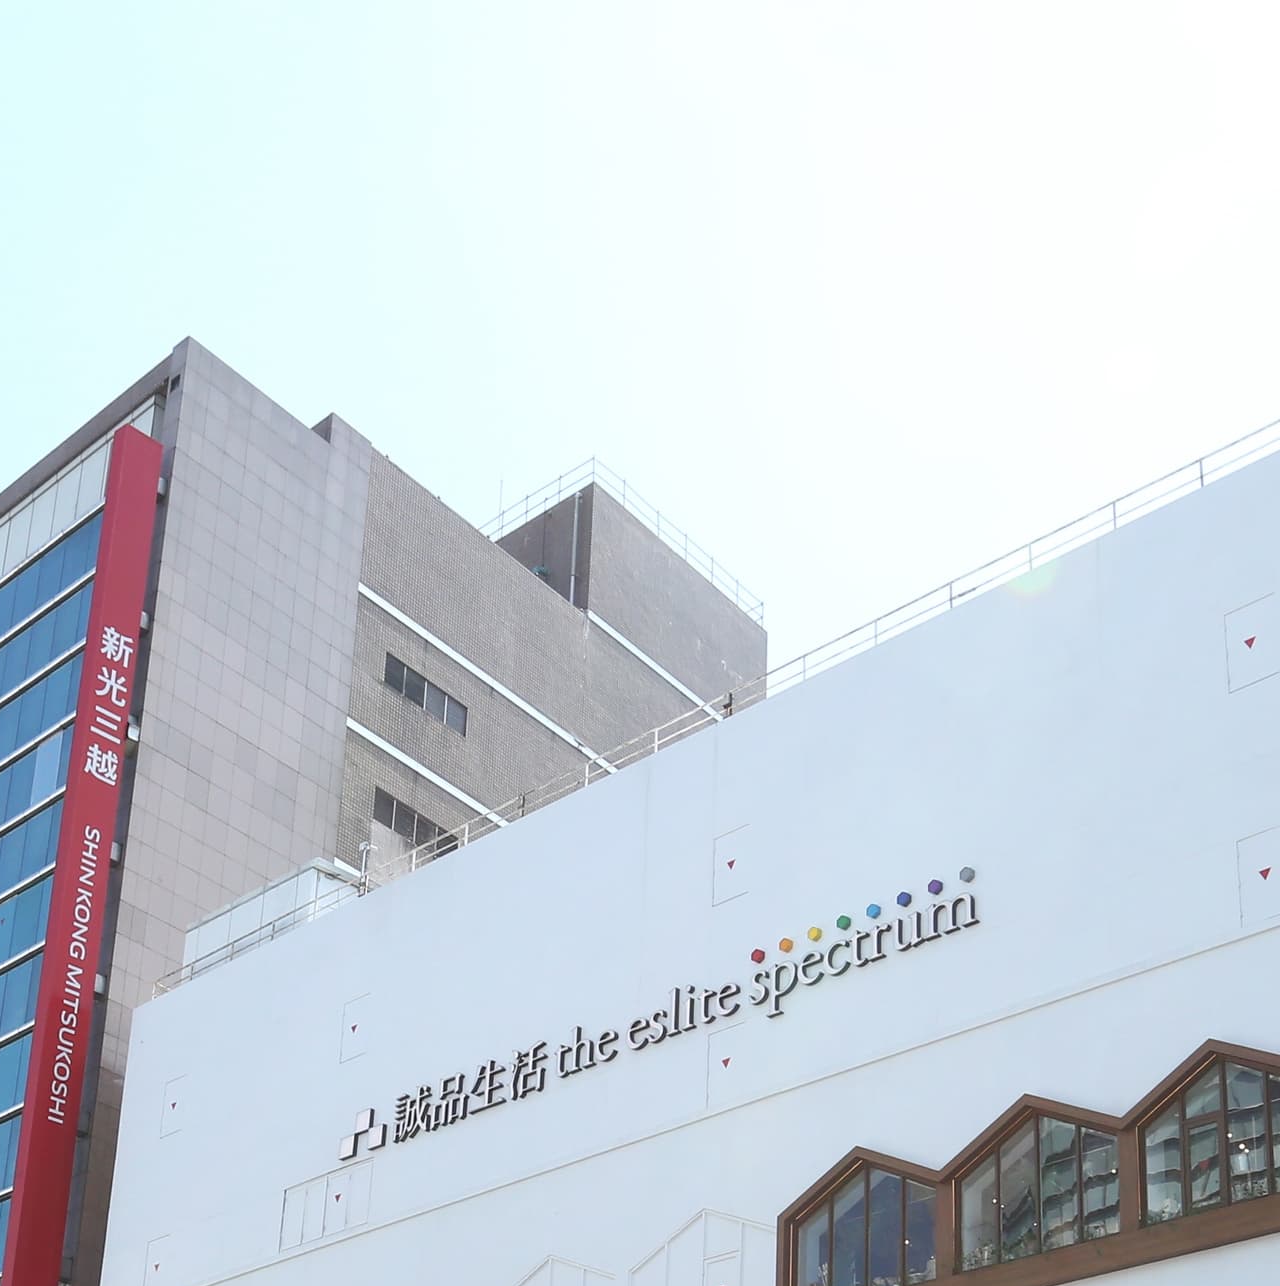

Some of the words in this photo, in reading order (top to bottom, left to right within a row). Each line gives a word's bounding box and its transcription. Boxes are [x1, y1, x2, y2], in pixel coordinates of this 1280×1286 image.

[84, 626, 134, 787] 新光三越
[70, 888, 92, 960] KONG
[79, 825, 100, 888] SHIN
[48, 963, 83, 1124] MITSUKOSHI
[392, 1039, 547, 1143] 誠品生活
[556, 1026, 619, 1079] the
[627, 981, 741, 1052] eslite
[749, 890, 980, 1019] spectrum
